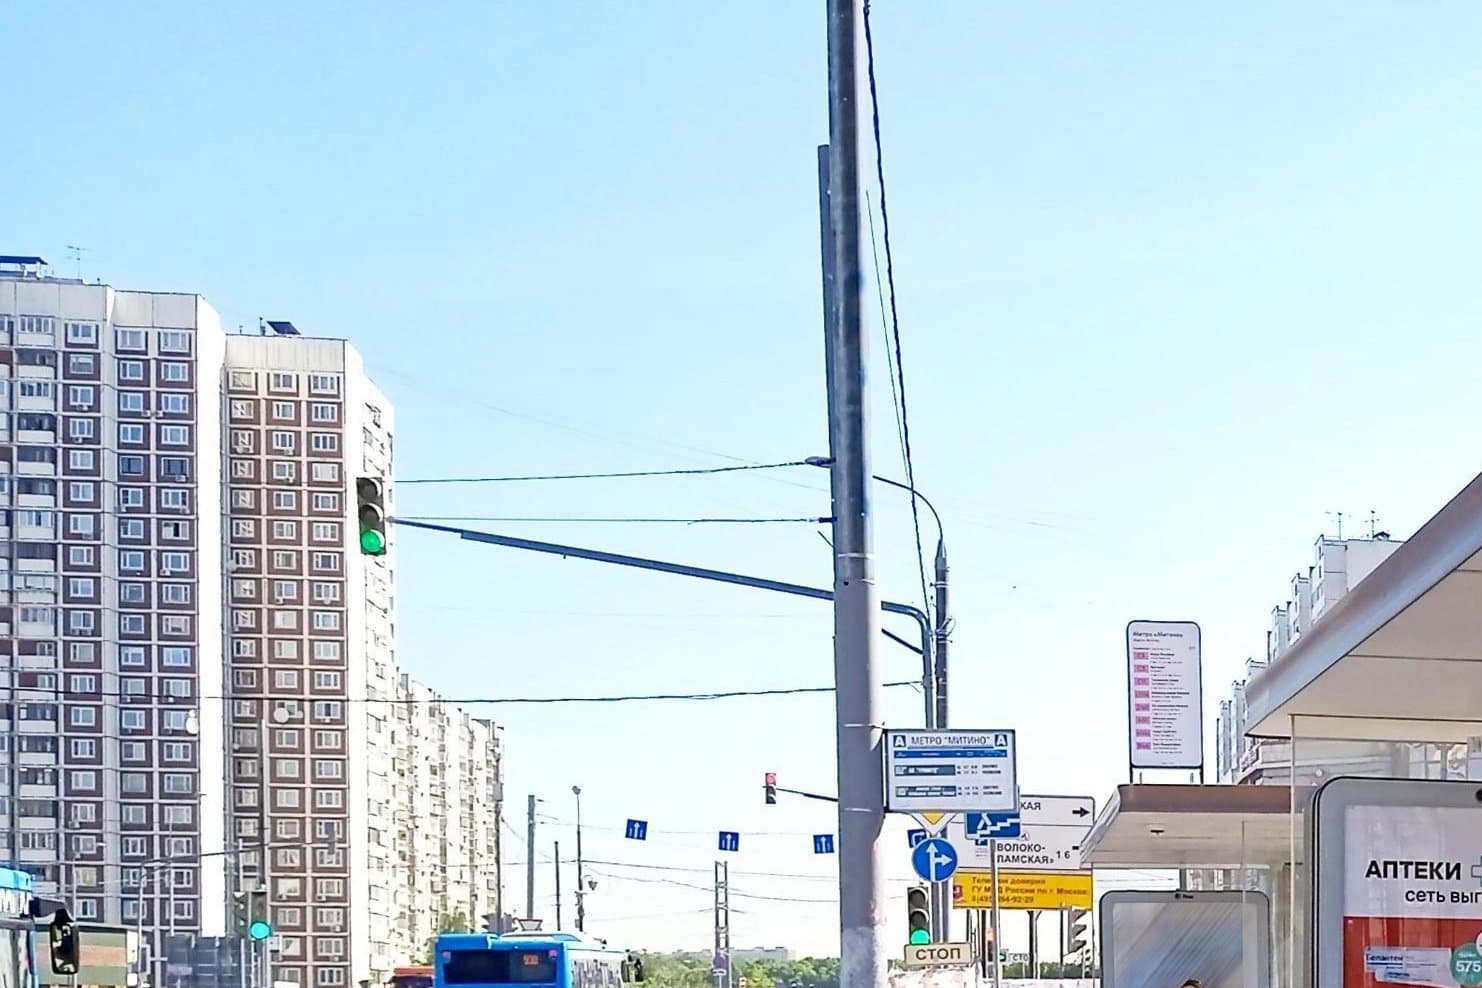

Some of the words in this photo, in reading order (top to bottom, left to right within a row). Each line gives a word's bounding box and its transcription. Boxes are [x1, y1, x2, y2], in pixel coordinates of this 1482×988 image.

[911, 736, 942, 745] МЕТРО
[1021, 802, 1041, 810] КАЯ
[997, 843, 1046, 853] ВОЛОКО-
[1365, 860, 1461, 881] АПТЕКИ
[984, 886, 1003, 894] МД
[1405, 889, 1446, 903] сеть
[915, 947, 961, 962] СТОП
